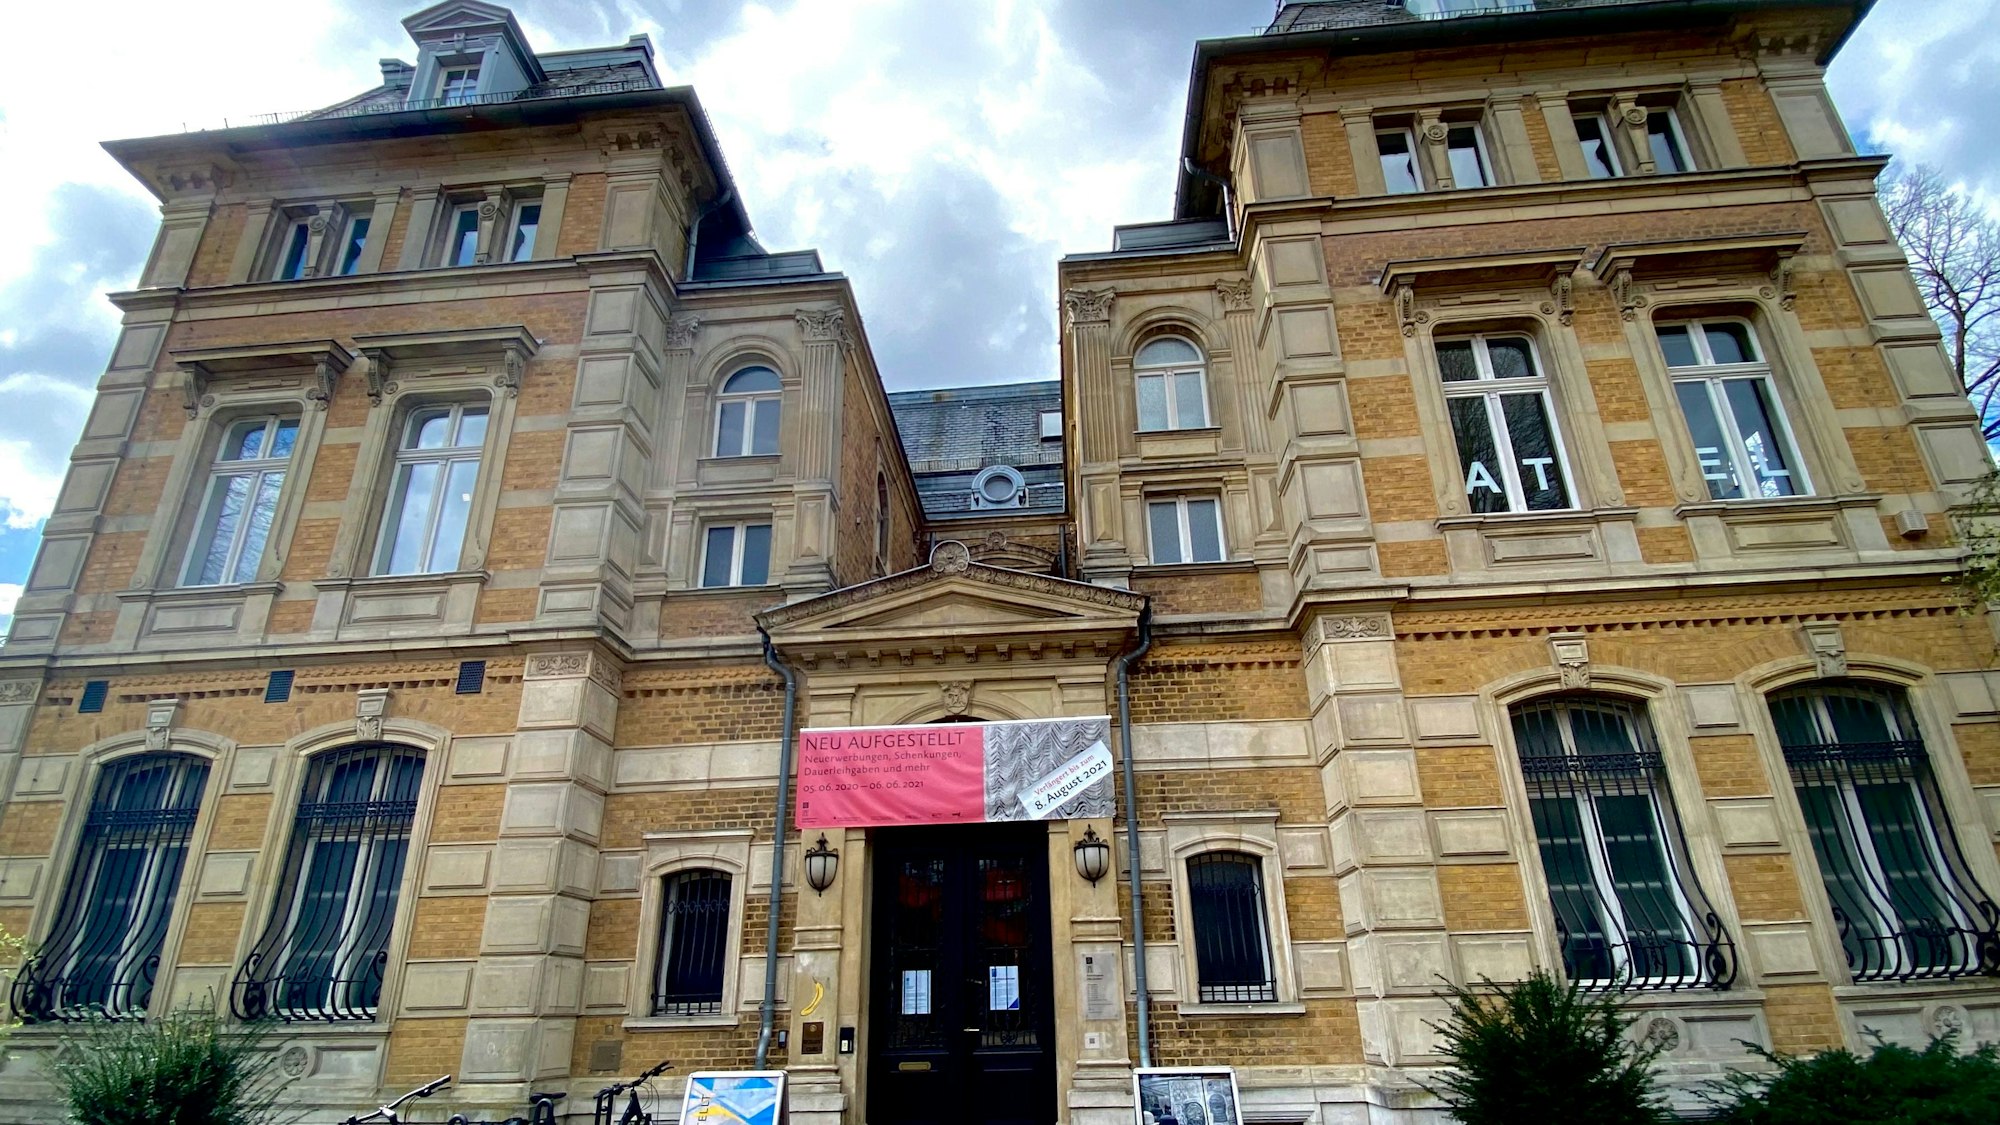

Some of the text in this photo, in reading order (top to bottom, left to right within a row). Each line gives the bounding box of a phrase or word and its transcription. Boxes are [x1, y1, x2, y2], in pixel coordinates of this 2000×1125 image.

[805, 731, 964, 751] NEU AUFGESTELLT
[804, 750, 961, 764] Neuerwerbungen, Schenkungen,
[803, 763, 930, 776] Dauerleihgaben und mehr
[1034, 754, 1095, 795] Verlängert bis zum
[1034, 760, 1107, 810] 8. August 2021
